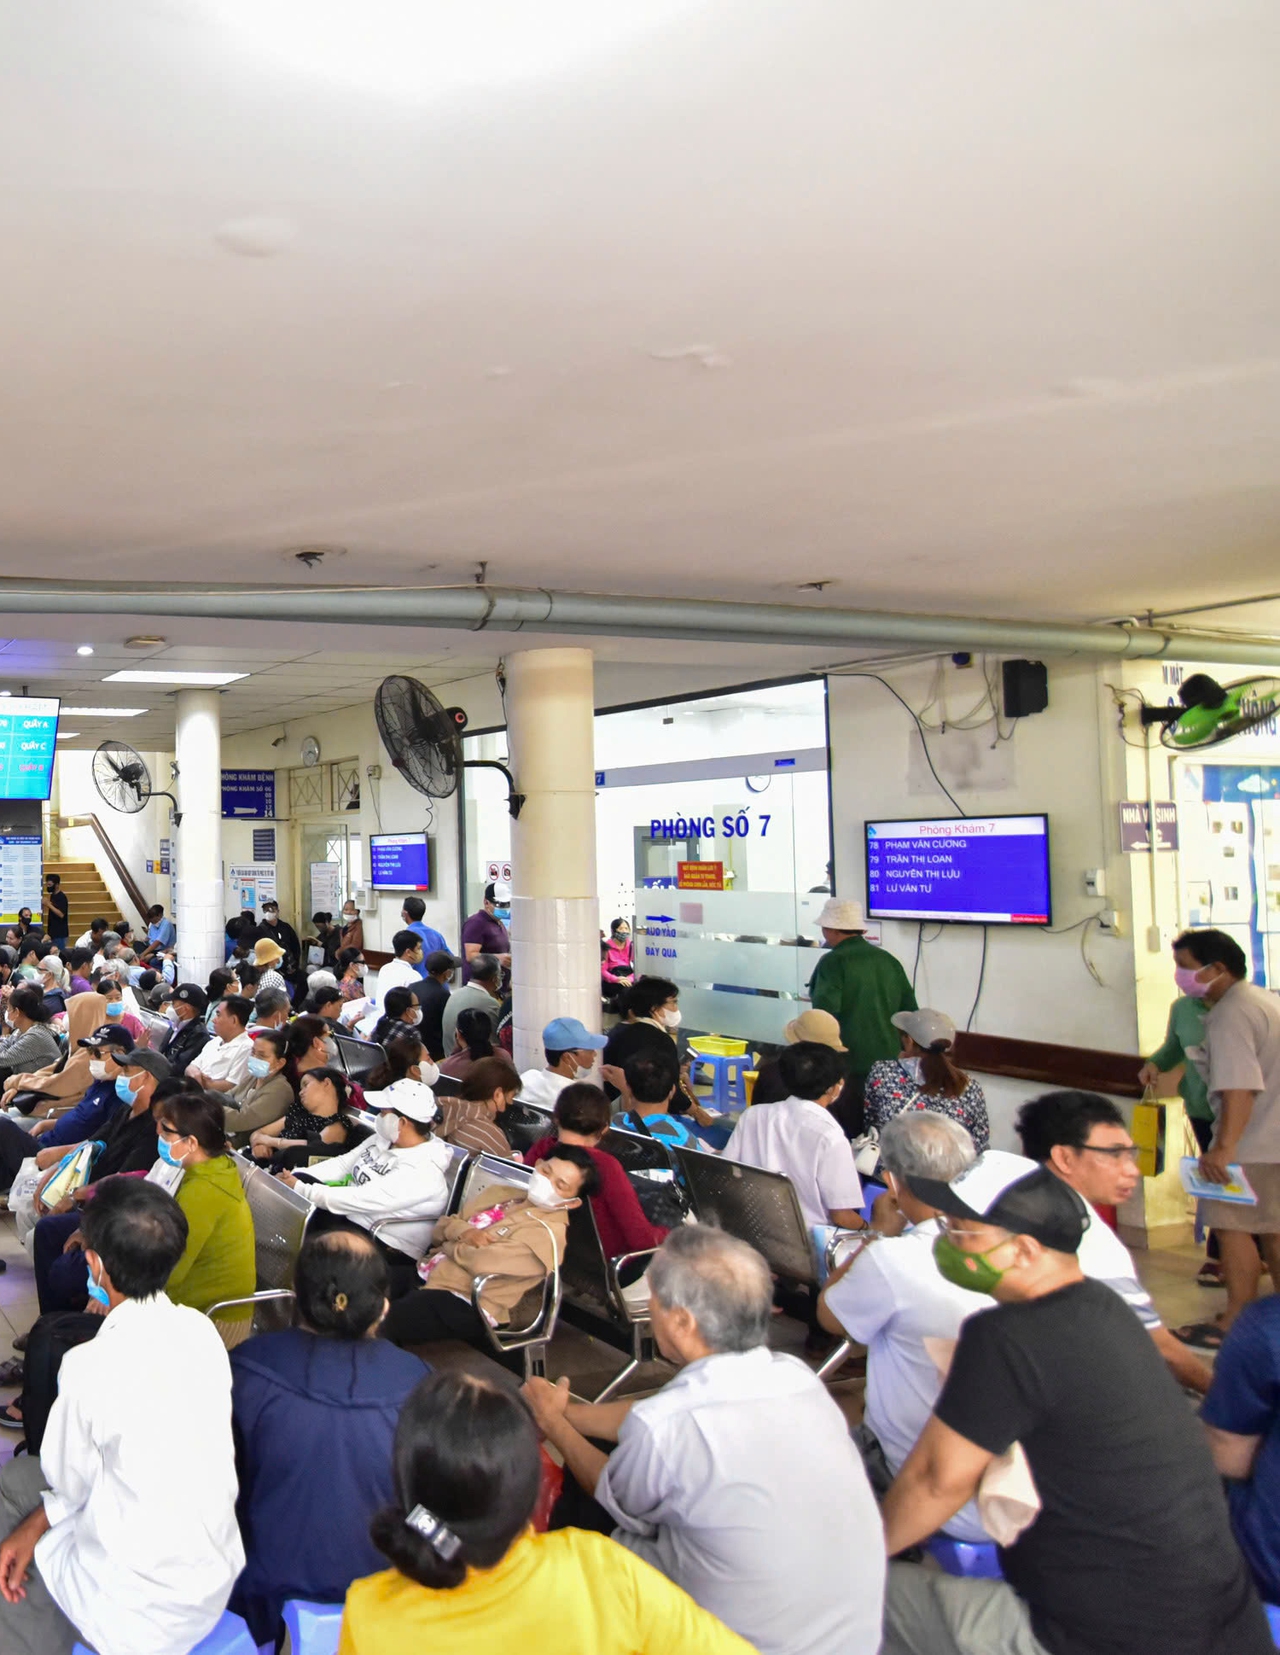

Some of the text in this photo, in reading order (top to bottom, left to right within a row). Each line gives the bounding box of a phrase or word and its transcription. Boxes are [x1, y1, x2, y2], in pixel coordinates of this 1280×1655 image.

[221, 772, 238, 781] HÒNG
[257, 772, 274, 782] BỆNH
[1122, 804, 1141, 824] NHÀ
[1155, 807, 1176, 823] SINH
[651, 806, 771, 839] PHÒNG SỐ 7
[920, 823, 995, 836] Phòng Khám 7
[870, 841, 879, 849] 78
[912, 840, 930, 849] VĂN
[911, 855, 925, 865] THỊ
[927, 855, 952, 863] LOAN
[870, 870, 879, 878] 80
[925, 870, 940, 879] THỊ
[870, 884, 879, 892] 81
[899, 884, 918, 892] VĂN
